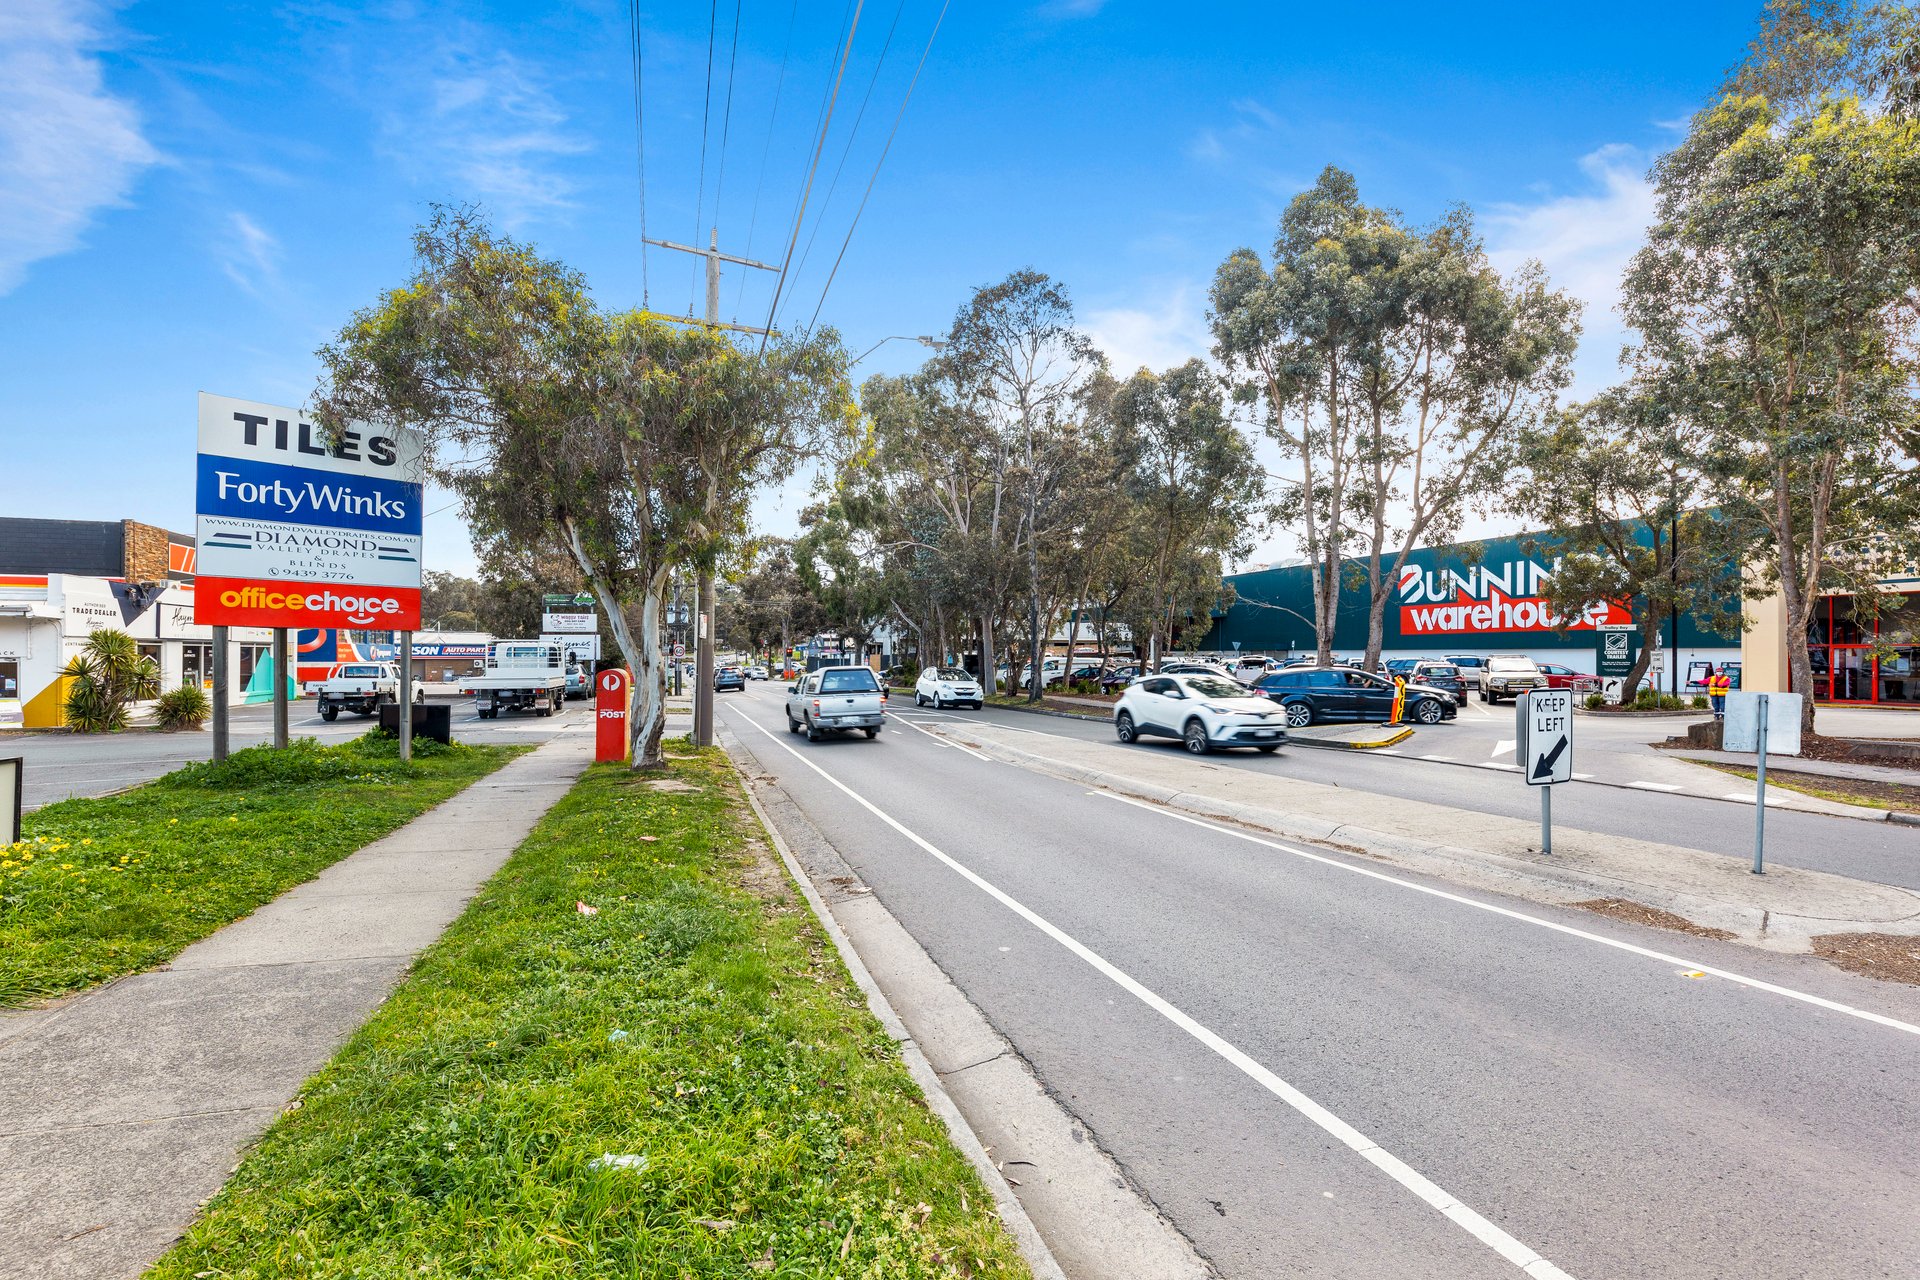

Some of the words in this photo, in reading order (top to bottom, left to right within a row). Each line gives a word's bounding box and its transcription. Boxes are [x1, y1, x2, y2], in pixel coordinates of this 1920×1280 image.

[234, 412, 397, 466] TILES
[205, 518, 417, 543] WWW.DIAMONDVALLEYDRAPES.COM.AU
[255, 531, 377, 551] DIAMOND
[257, 544, 311, 554] VALLEY
[320, 549, 375, 559] DRAPES
[289, 560, 347, 570] BLINDS
[282, 569, 317, 578] 9439
[321, 571, 355, 581] 3776
[72, 607, 94, 615] TRADE
[94, 608, 117, 617] DEALER
[600, 711, 626, 719] POST
[1537, 717, 1565, 732] LEFT
